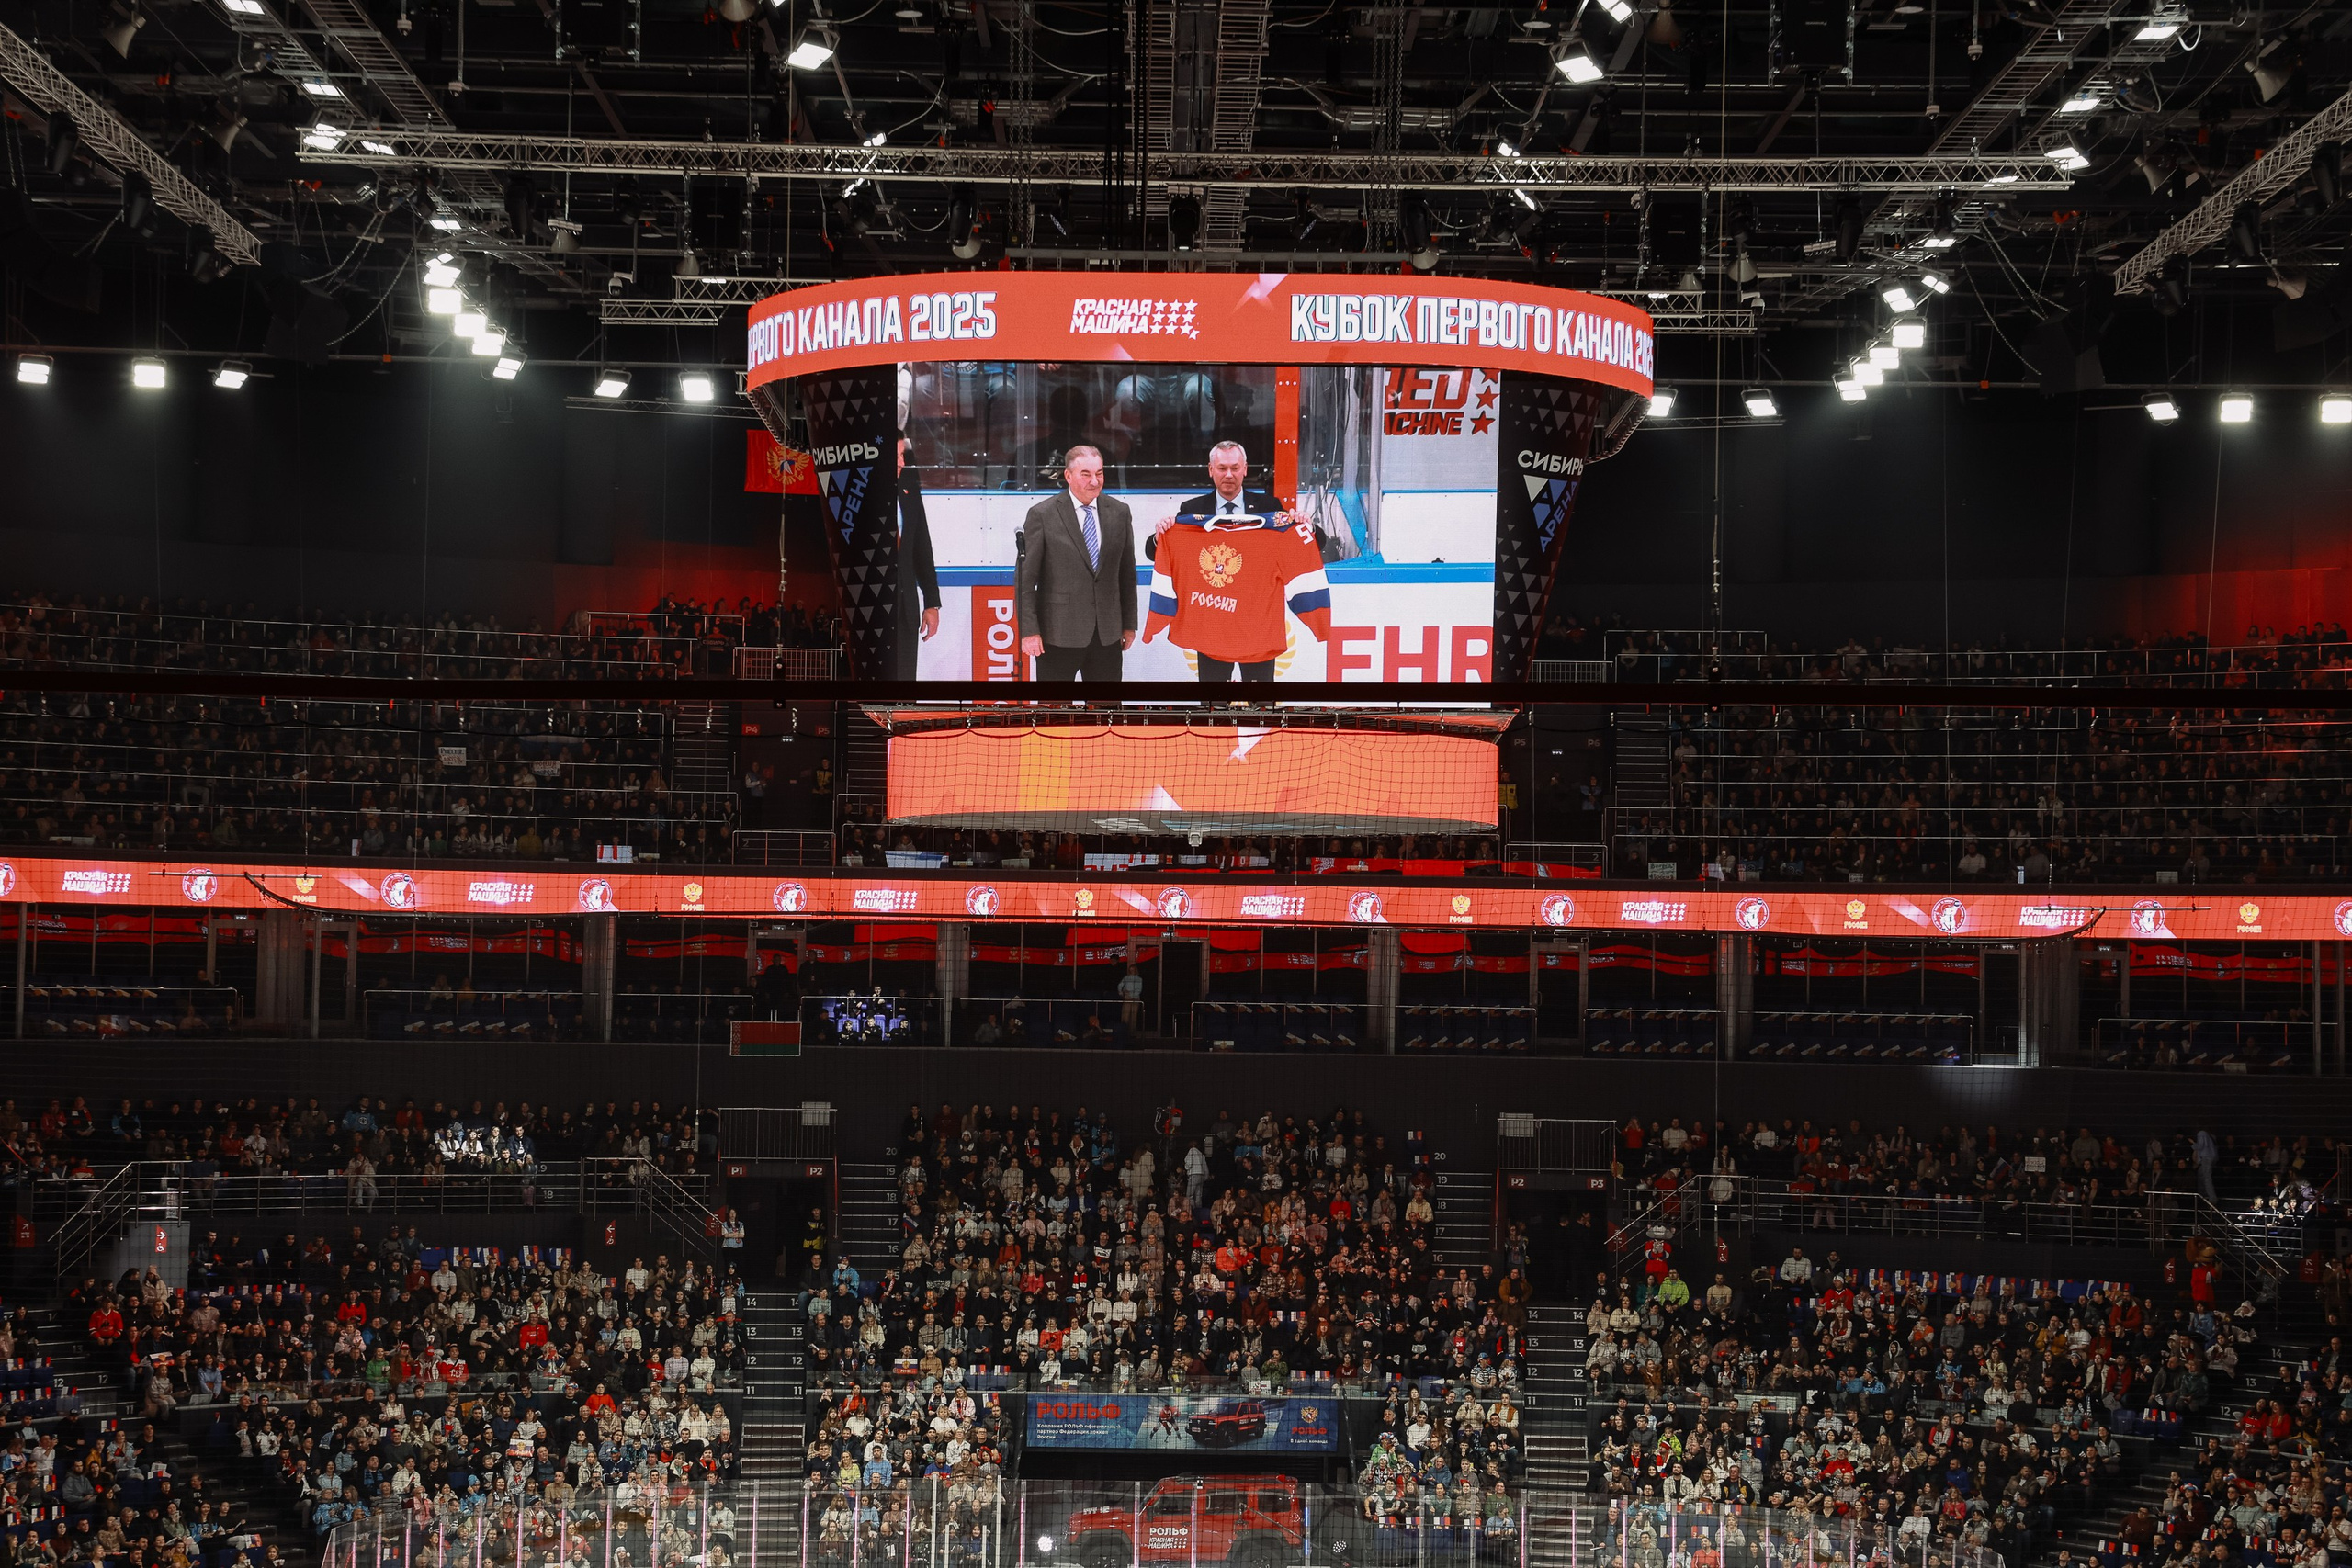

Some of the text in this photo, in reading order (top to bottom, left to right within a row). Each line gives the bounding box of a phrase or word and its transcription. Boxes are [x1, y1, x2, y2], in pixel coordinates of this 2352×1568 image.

[1072, 299, 1153, 316] КРАСНАЯ
[1069, 314, 1149, 334] МАШИНА
[748, 290, 999, 372] ЕРВОГО КАНАЛА 2025
[1290, 293, 1414, 343] КУБОК
[1416, 296, 1553, 354] ПЕРВОГО
[1556, 309, 1634, 370] КАНАЛА
[812, 442, 879, 466] СИБИРЬ
[1517, 449, 1584, 476] СИБИРЬ
[841, 466, 874, 545] АРЕНА
[1539, 481, 1578, 554] АРЕНА
[1190, 592, 1238, 613] РОССИЯ
[1327, 626, 1494, 682] FHR
[745, 726, 758, 734] P4
[818, 727, 830, 735] P5
[742, 840, 750, 848] 2
[822, 840, 830, 849] 2
[1592, 853, 1599, 862] 2
[64, 870, 108, 881] КРАСНАЯ
[62, 880, 107, 892] МАШИНА
[469, 882, 512, 892] КРАСНАЯ
[468, 891, 511, 902] МАШИНА
[854, 889, 896, 900] КРАСНАЯ
[853, 898, 895, 910] МАШИНА
[1242, 896, 1283, 906] КРАСНАЯ
[1240, 904, 1283, 916] МАШИНА
[1623, 901, 1664, 911] КРАСНАЯ
[1621, 910, 1663, 921] МАШИНА
[2019, 915, 2062, 926] МАШИНА
[885, 1147, 898, 1156] 20
[1434, 1152, 1446, 1160] 20
[731, 1167, 743, 1175] P1
[809, 1167, 823, 1176] P2
[886, 1168, 896, 1176] 19
[1437, 1176, 1447, 1184] 19
[1511, 1178, 1524, 1187] P2
[1590, 1179, 1604, 1189] P3
[886, 1192, 897, 1201] 18
[1437, 1201, 1447, 1210] 18
[888, 1218, 899, 1226] 17
[1435, 1227, 1445, 1235] 17
[888, 1245, 899, 1254] 16
[1432, 1254, 1443, 1263] 16
[746, 1298, 757, 1306] 14
[1528, 1310, 1539, 1319] 14
[1573, 1311, 1584, 1320] 14
[746, 1327, 757, 1337] 13
[791, 1327, 803, 1337] 13
[1528, 1338, 1539, 1348] 13
[1573, 1339, 1584, 1348] 13
[73, 1345, 83, 1354] 13
[2272, 1348, 2282, 1359] 14
[746, 1356, 757, 1364] 12
[792, 1356, 803, 1365] 12
[1526, 1367, 1538, 1376] 12
[1573, 1369, 1584, 1378] 12
[53, 1378, 64, 1387] 12
[98, 1375, 108, 1384] 12
[2245, 1378, 2256, 1387] 13
[746, 1386, 755, 1395] 11
[794, 1386, 802, 1395] 11
[1528, 1396, 1536, 1405] 11
[1574, 1397, 1583, 1406] 11
[126, 1405, 134, 1415] 11
[1036, 1402, 1121, 1419] РОЛЬФ
[2221, 1406, 2231, 1416] 12
[1291, 1427, 1327, 1435] РОЛЬФ
[2194, 1437, 2203, 1446] 11
[1149, 1527, 1189, 1536] РОЛЬФ
